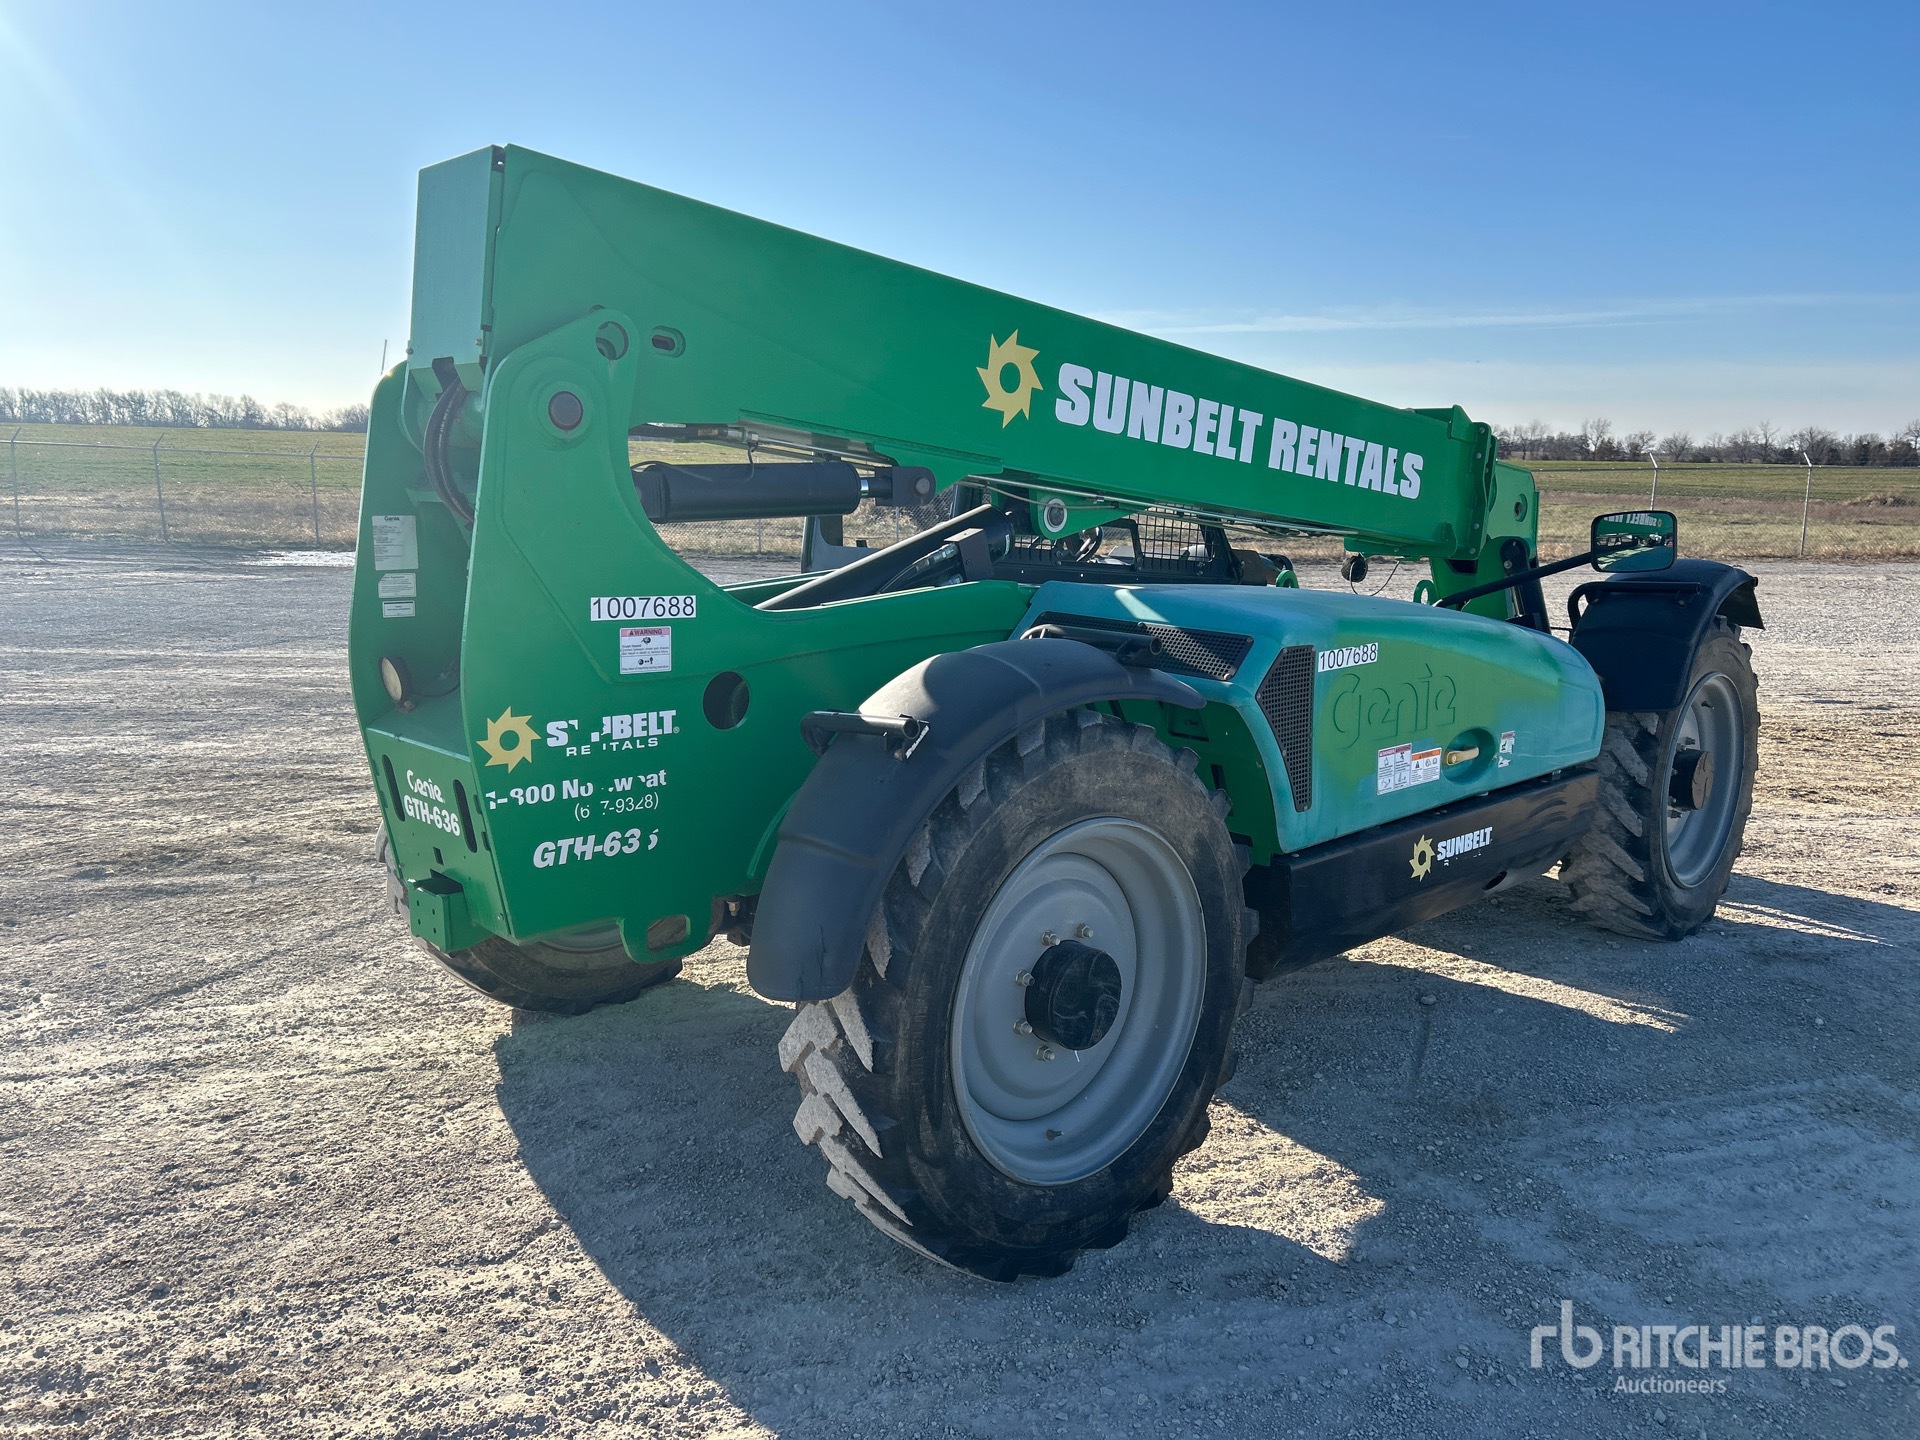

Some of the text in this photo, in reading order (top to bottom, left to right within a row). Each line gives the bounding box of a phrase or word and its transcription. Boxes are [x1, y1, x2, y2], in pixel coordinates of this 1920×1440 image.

[1056, 362, 1424, 500] SUNBELT RENTALS
[593, 596, 694, 619] 1007688
[1320, 643, 1377, 670] 1007688
[566, 737, 659, 757] RETALS
[403, 794, 461, 837] GTH-636
[1437, 826, 1493, 861] SUNBELT
